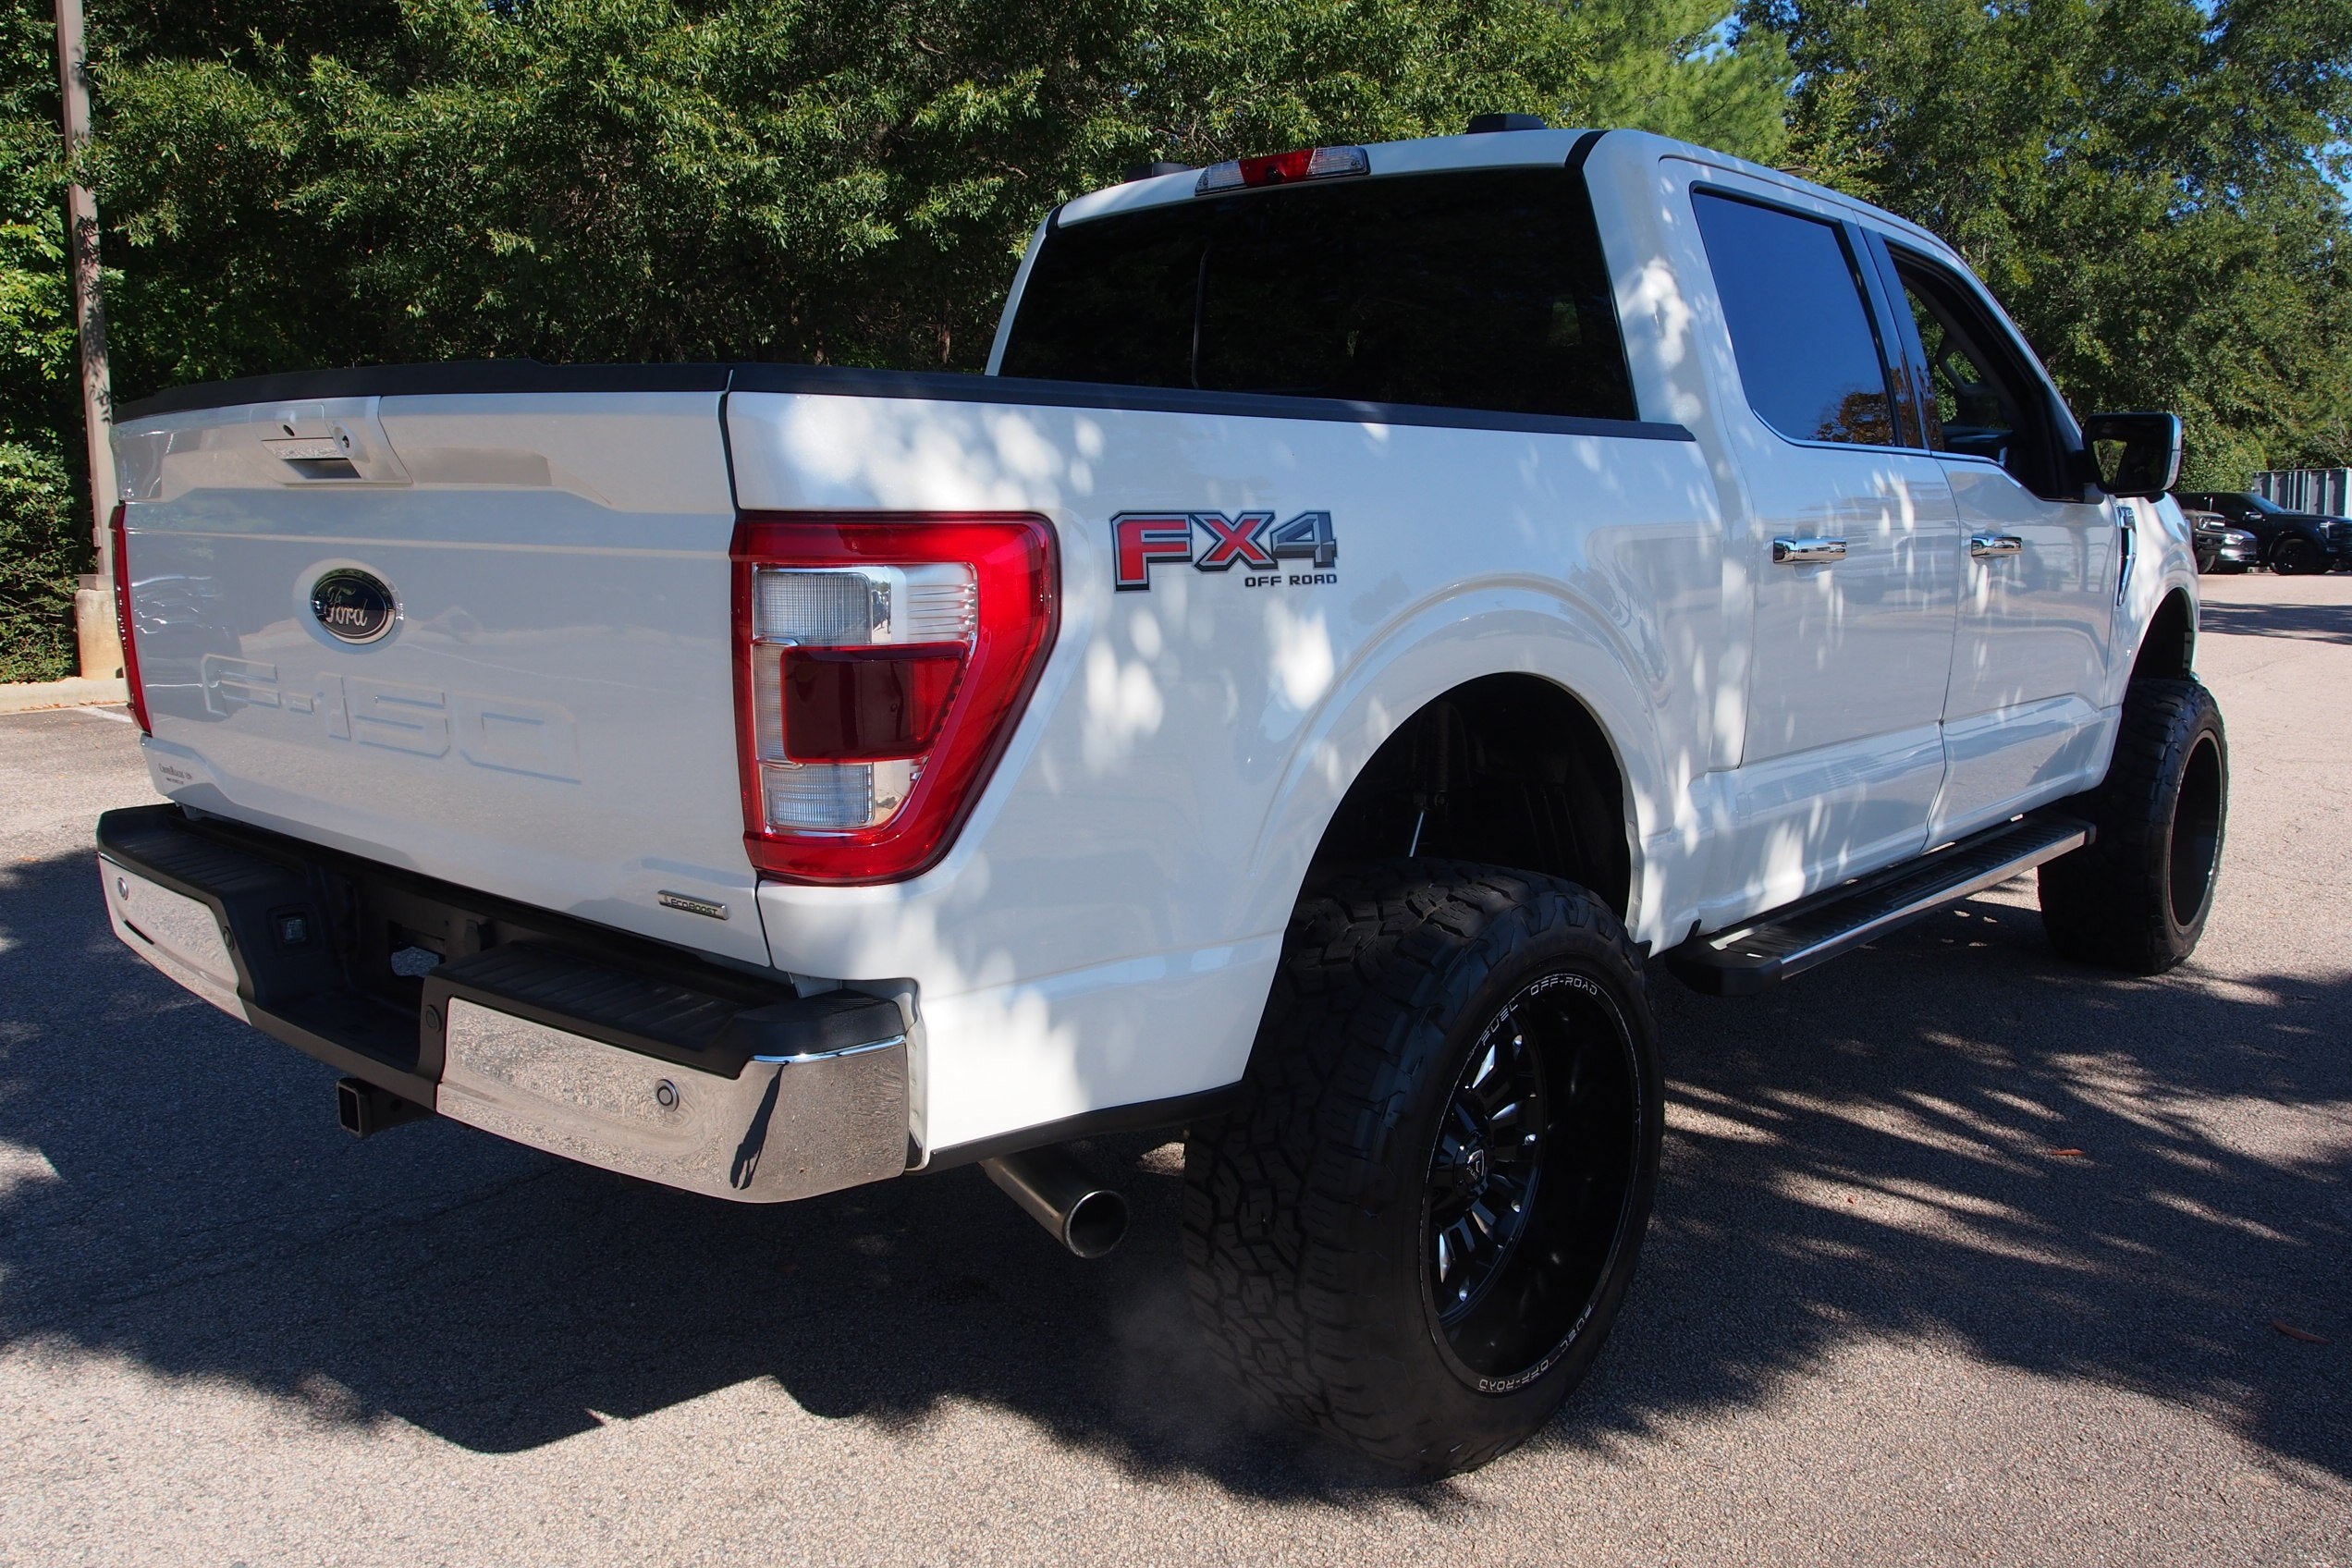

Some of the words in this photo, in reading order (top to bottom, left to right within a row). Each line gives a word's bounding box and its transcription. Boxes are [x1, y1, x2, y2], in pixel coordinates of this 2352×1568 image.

[1109, 510, 1338, 594] FX4
[1244, 575, 1282, 588] OFF
[1289, 573, 1338, 586] ROAD
[324, 585, 370, 627] Ford
[201, 653, 584, 786] F-150
[1481, 1003, 1519, 1047] FUEL
[1530, 976, 1598, 996] OFF-ROAD
[1559, 1304, 1592, 1350] FUEL
[1479, 1359, 1550, 1390] OFF-ROAD
